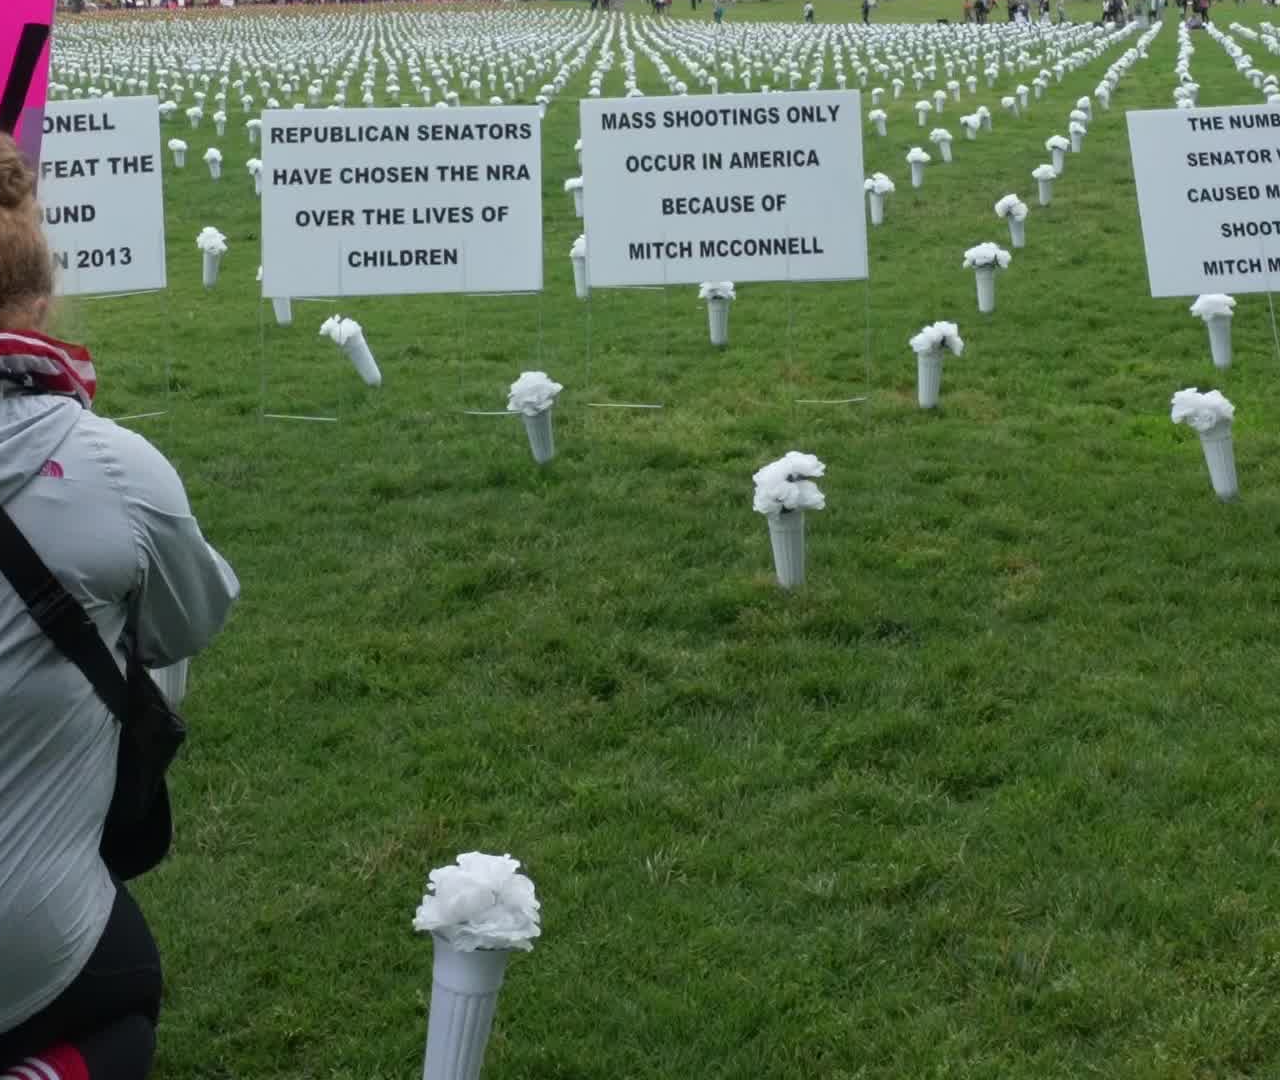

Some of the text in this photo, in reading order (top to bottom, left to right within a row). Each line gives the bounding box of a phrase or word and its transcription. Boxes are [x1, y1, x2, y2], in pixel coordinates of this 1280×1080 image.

[42, 112, 116, 135] ONELL
[601, 104, 841, 131] MASS SHOOTINGS ONLY
[1187, 116, 1224, 132] THE
[270, 122, 533, 145] REPUBLICAN SENATORS
[40, 154, 155, 179] FEAT THE
[625, 148, 821, 174] OCCUR IN AMERICA
[1186, 148, 1273, 168] SENATOR
[272, 163, 531, 186] HAVE CHOSEN THE NRA
[661, 193, 787, 217] BECAUSE OF
[1186, 185, 1261, 204] CAUSED
[44, 203, 96, 225] UND
[295, 205, 510, 228] OVER THE LIVES OF
[76, 246, 133, 269] 2013
[347, 247, 458, 269] CHILDREN
[628, 236, 825, 261] MITCH MCCONNELL
[1202, 257, 1263, 277] MITCH
